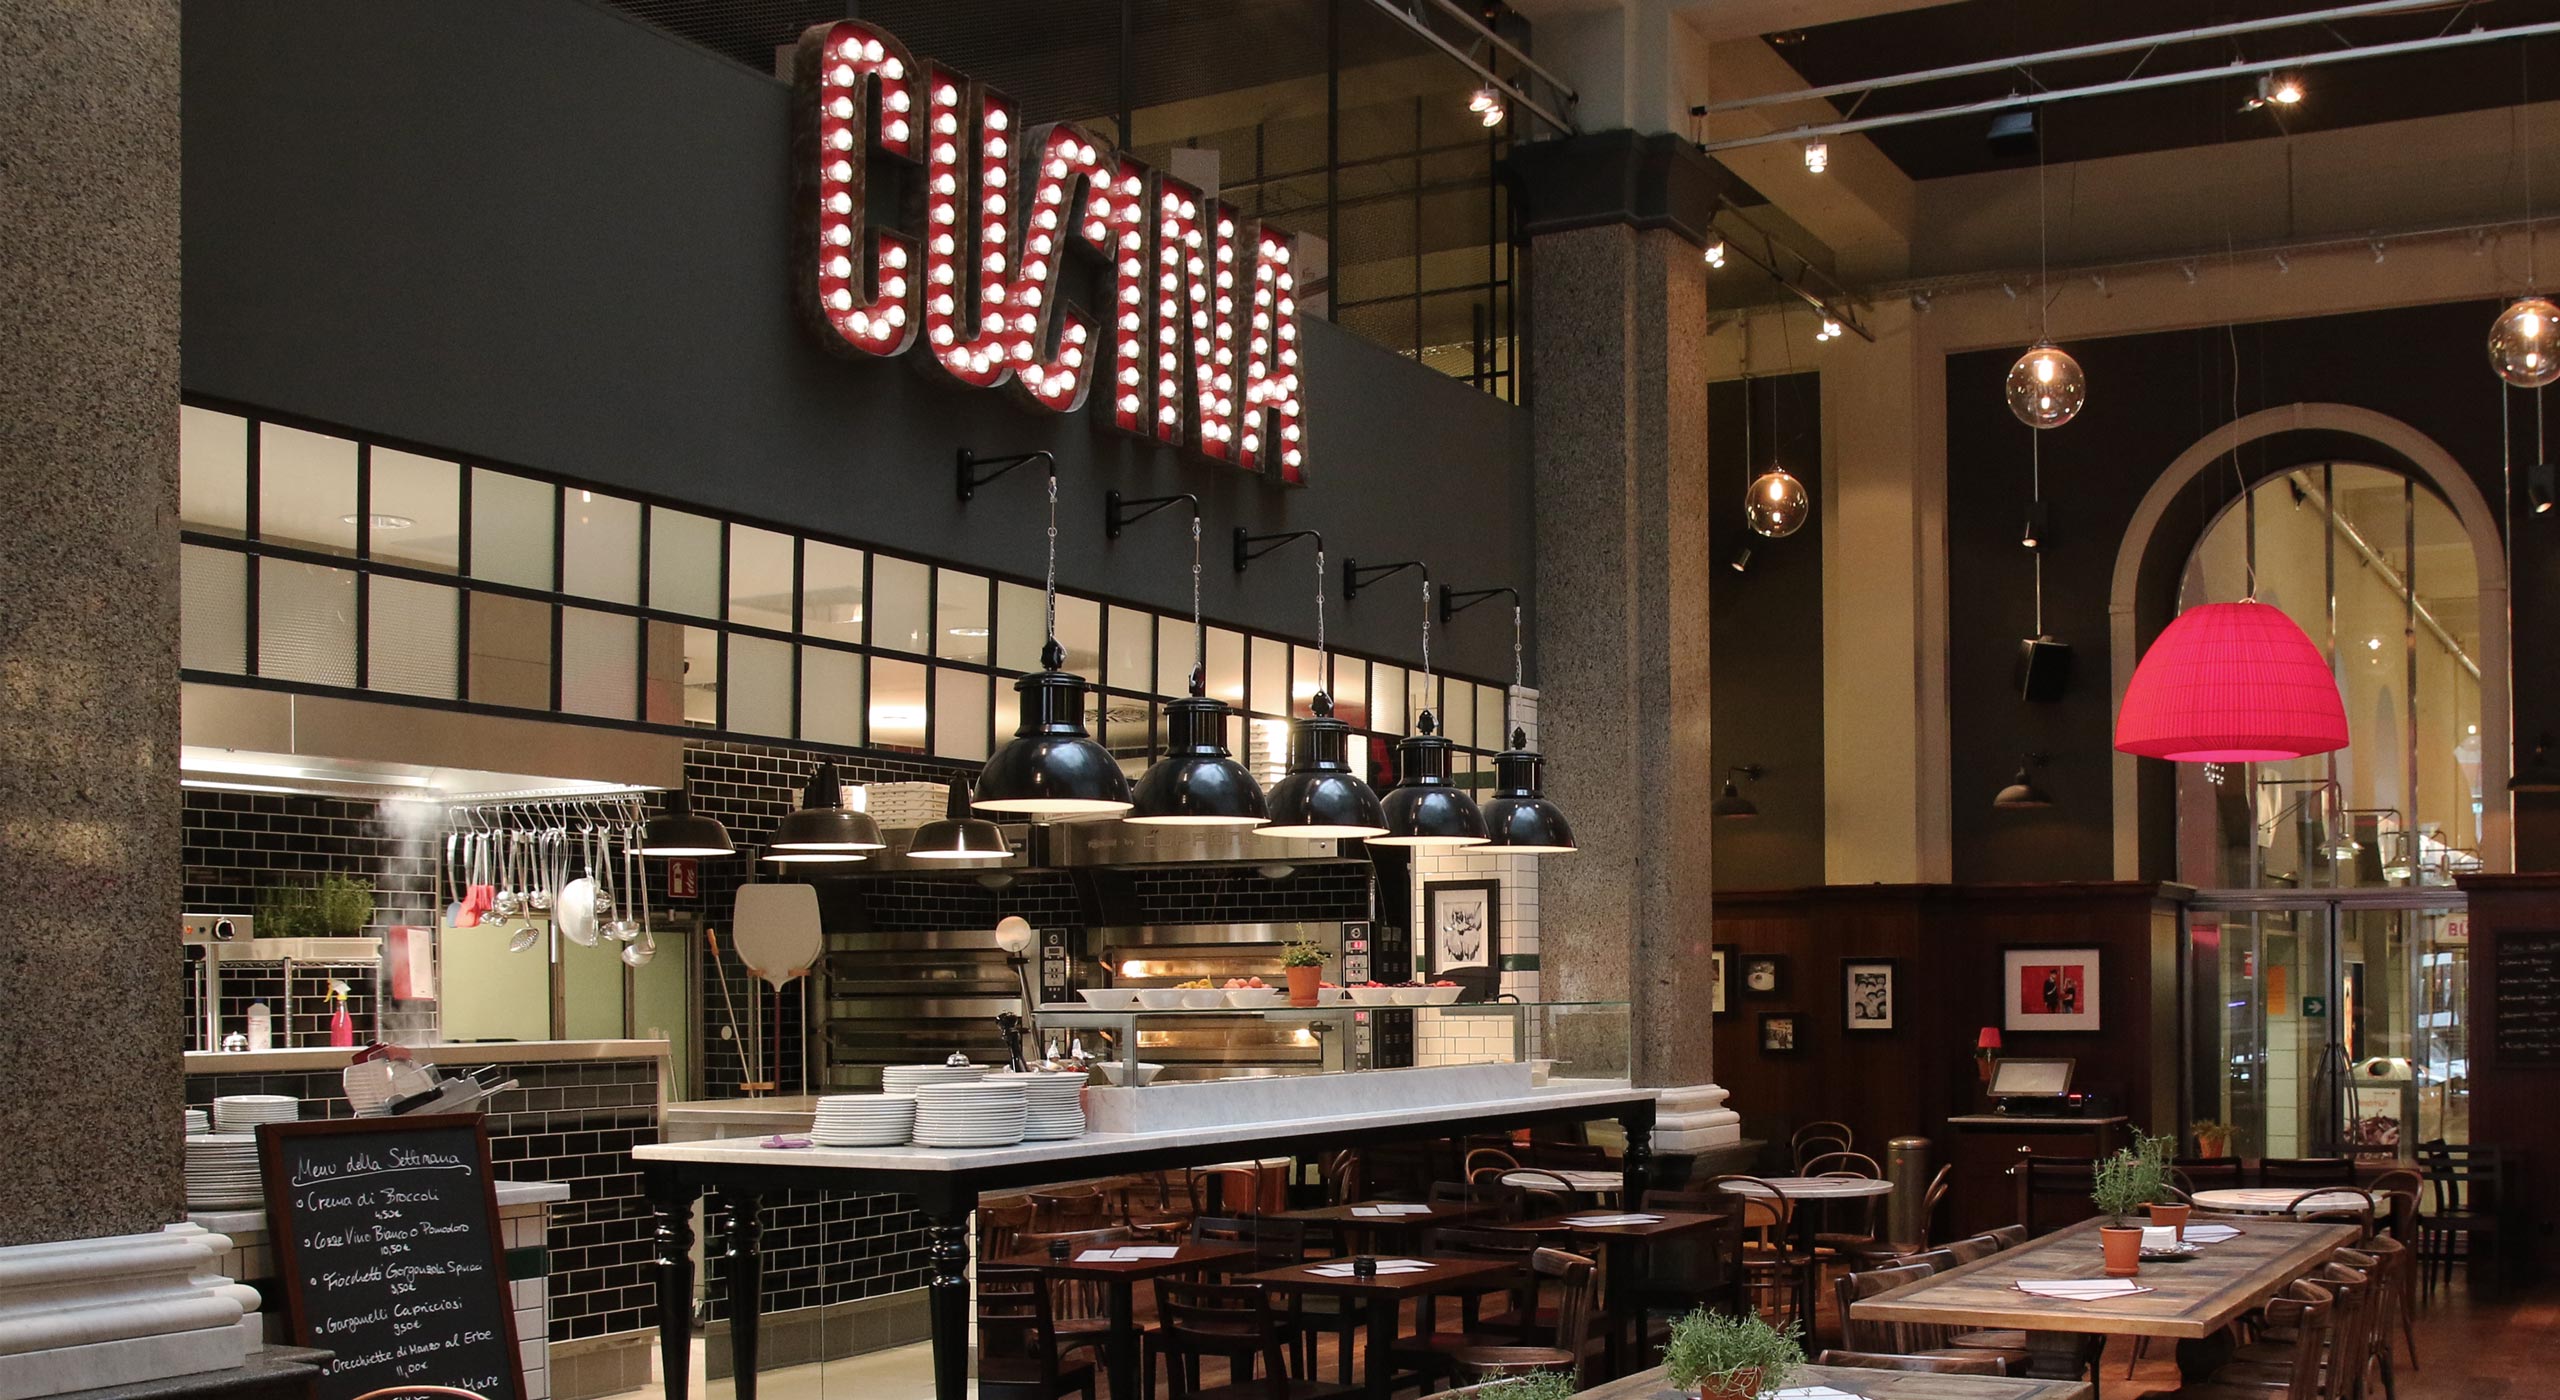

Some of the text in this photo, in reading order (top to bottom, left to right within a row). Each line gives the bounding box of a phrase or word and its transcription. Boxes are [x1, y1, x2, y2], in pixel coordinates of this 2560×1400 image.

[798, 18, 1308, 488] CUCINA
[346, 1152, 382, 1171] della
[387, 1147, 461, 1168] Settimana
[308, 1187, 439, 1211] Crema di Broccoli
[345, 1226, 371, 1244] Vino
[372, 1225, 408, 1242] Bianco
[419, 1221, 469, 1235] Pomodoro
[394, 1297, 463, 1318] Capricciosi
[332, 1329, 495, 1374] Orecchiette di Manzo al Erbe
[462, 1375, 500, 1391] Mare
